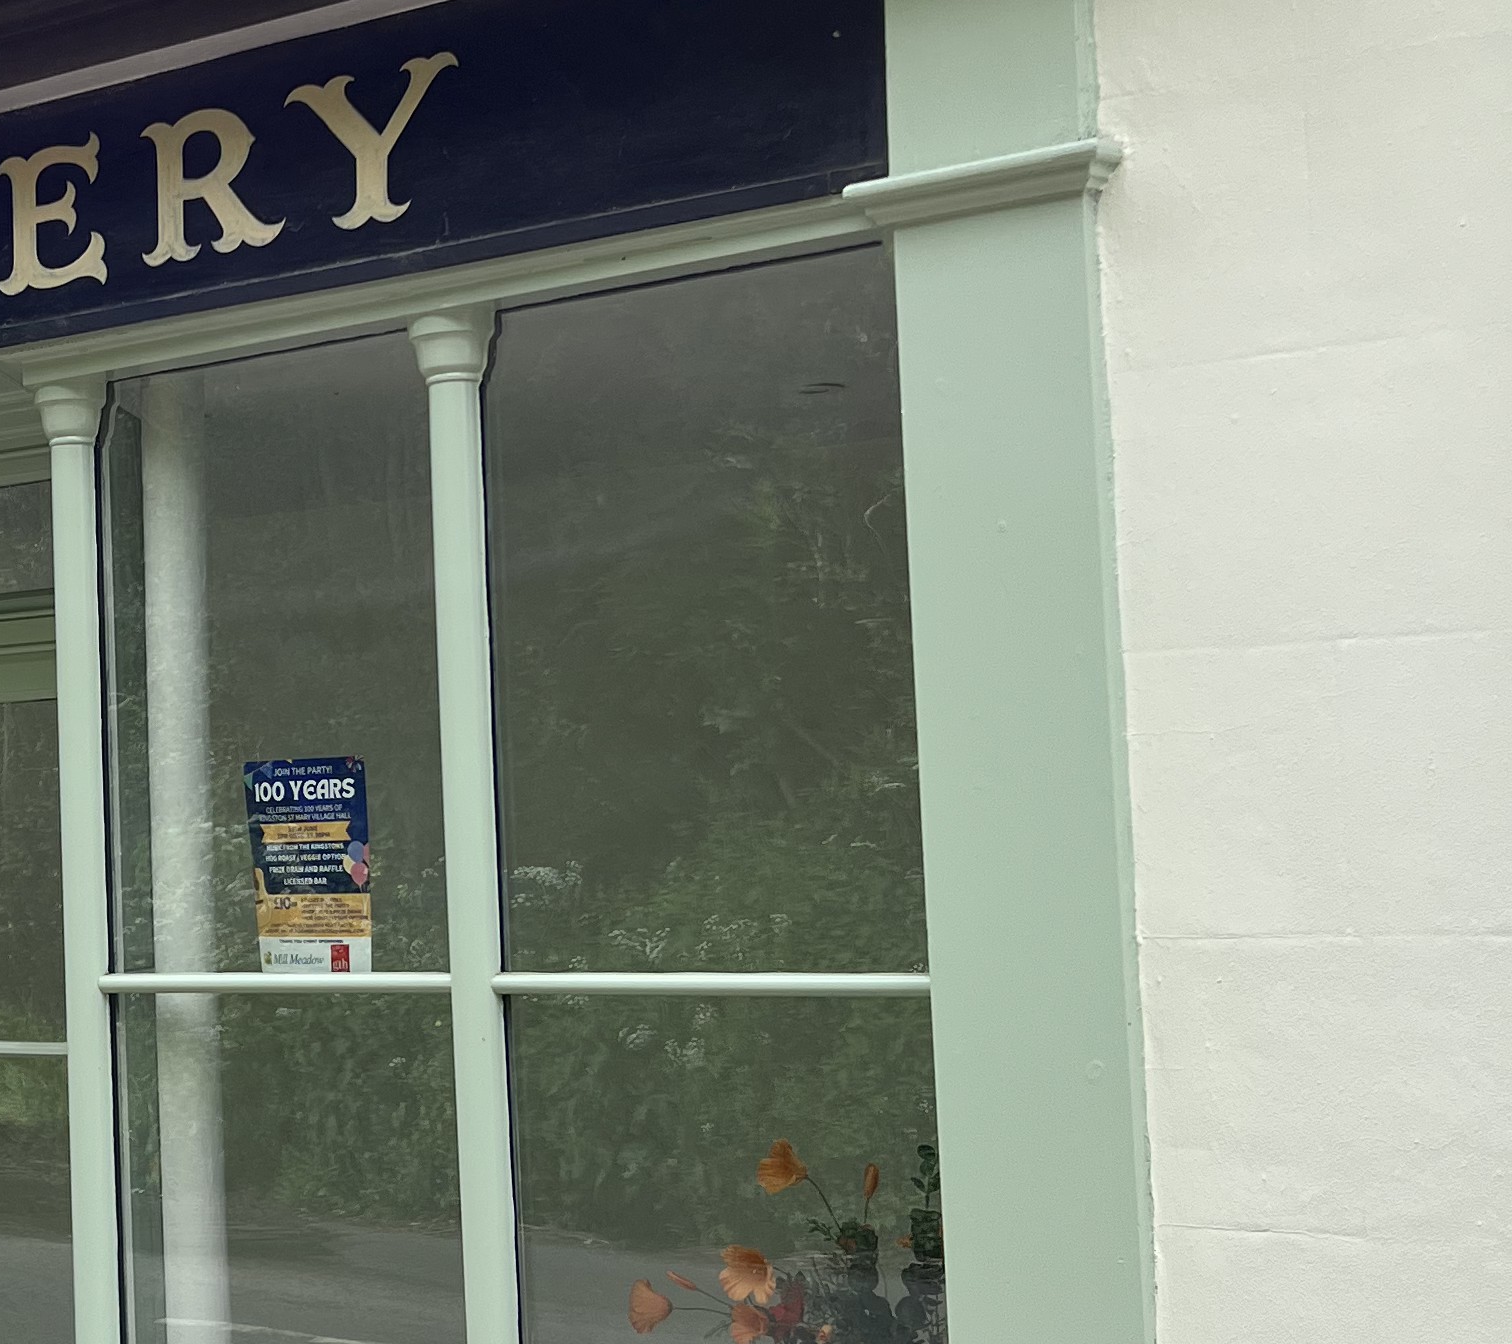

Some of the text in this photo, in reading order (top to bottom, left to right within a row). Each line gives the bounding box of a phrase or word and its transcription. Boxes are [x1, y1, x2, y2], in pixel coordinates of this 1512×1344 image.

[274, 768, 290, 777] JOIN
[291, 766, 306, 776] THE
[254, 777, 356, 803] 100 YEARS
[312, 812, 336, 821] VILLAGE
[304, 865, 318, 873] AND
[319, 864, 344, 873] RAFFLE
[289, 953, 325, 965] Meadow
